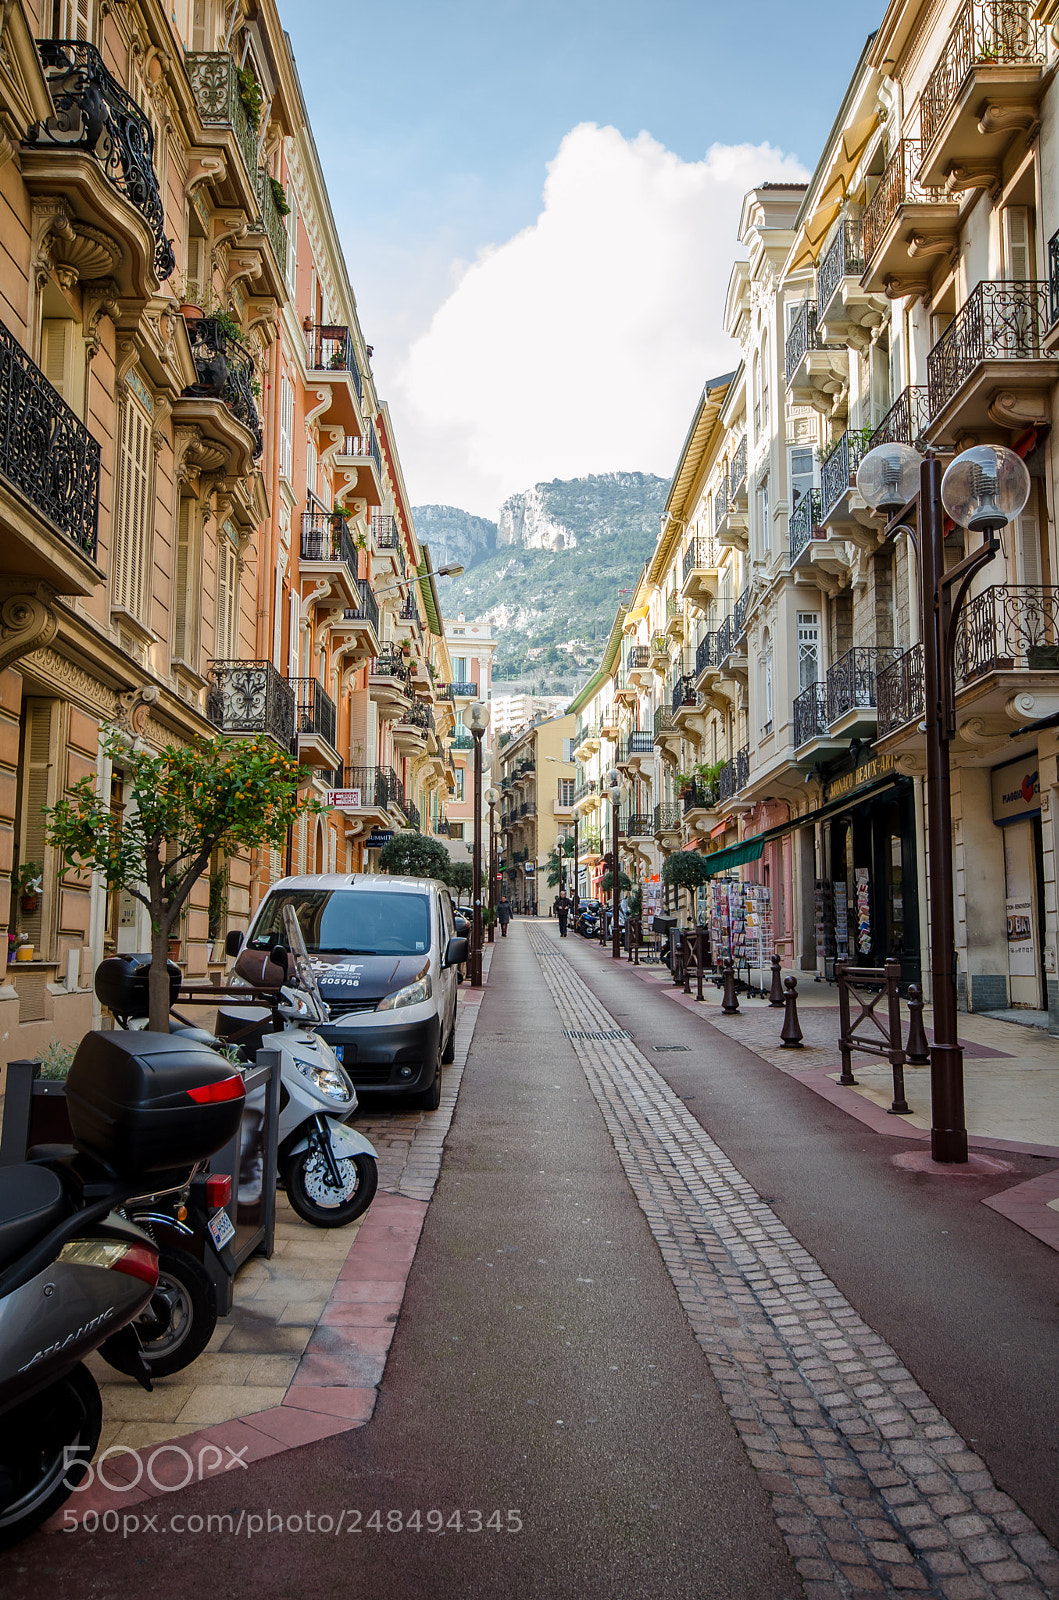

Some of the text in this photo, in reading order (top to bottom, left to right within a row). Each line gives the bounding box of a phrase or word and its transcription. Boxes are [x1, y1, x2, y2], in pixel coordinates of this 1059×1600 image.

[829, 773, 854, 799] MONACO
[1002, 789, 1023, 804] PIAGGIO
[320, 977, 360, 987] 505988
[17, 1306, 115, 1372] ATLANTIC
